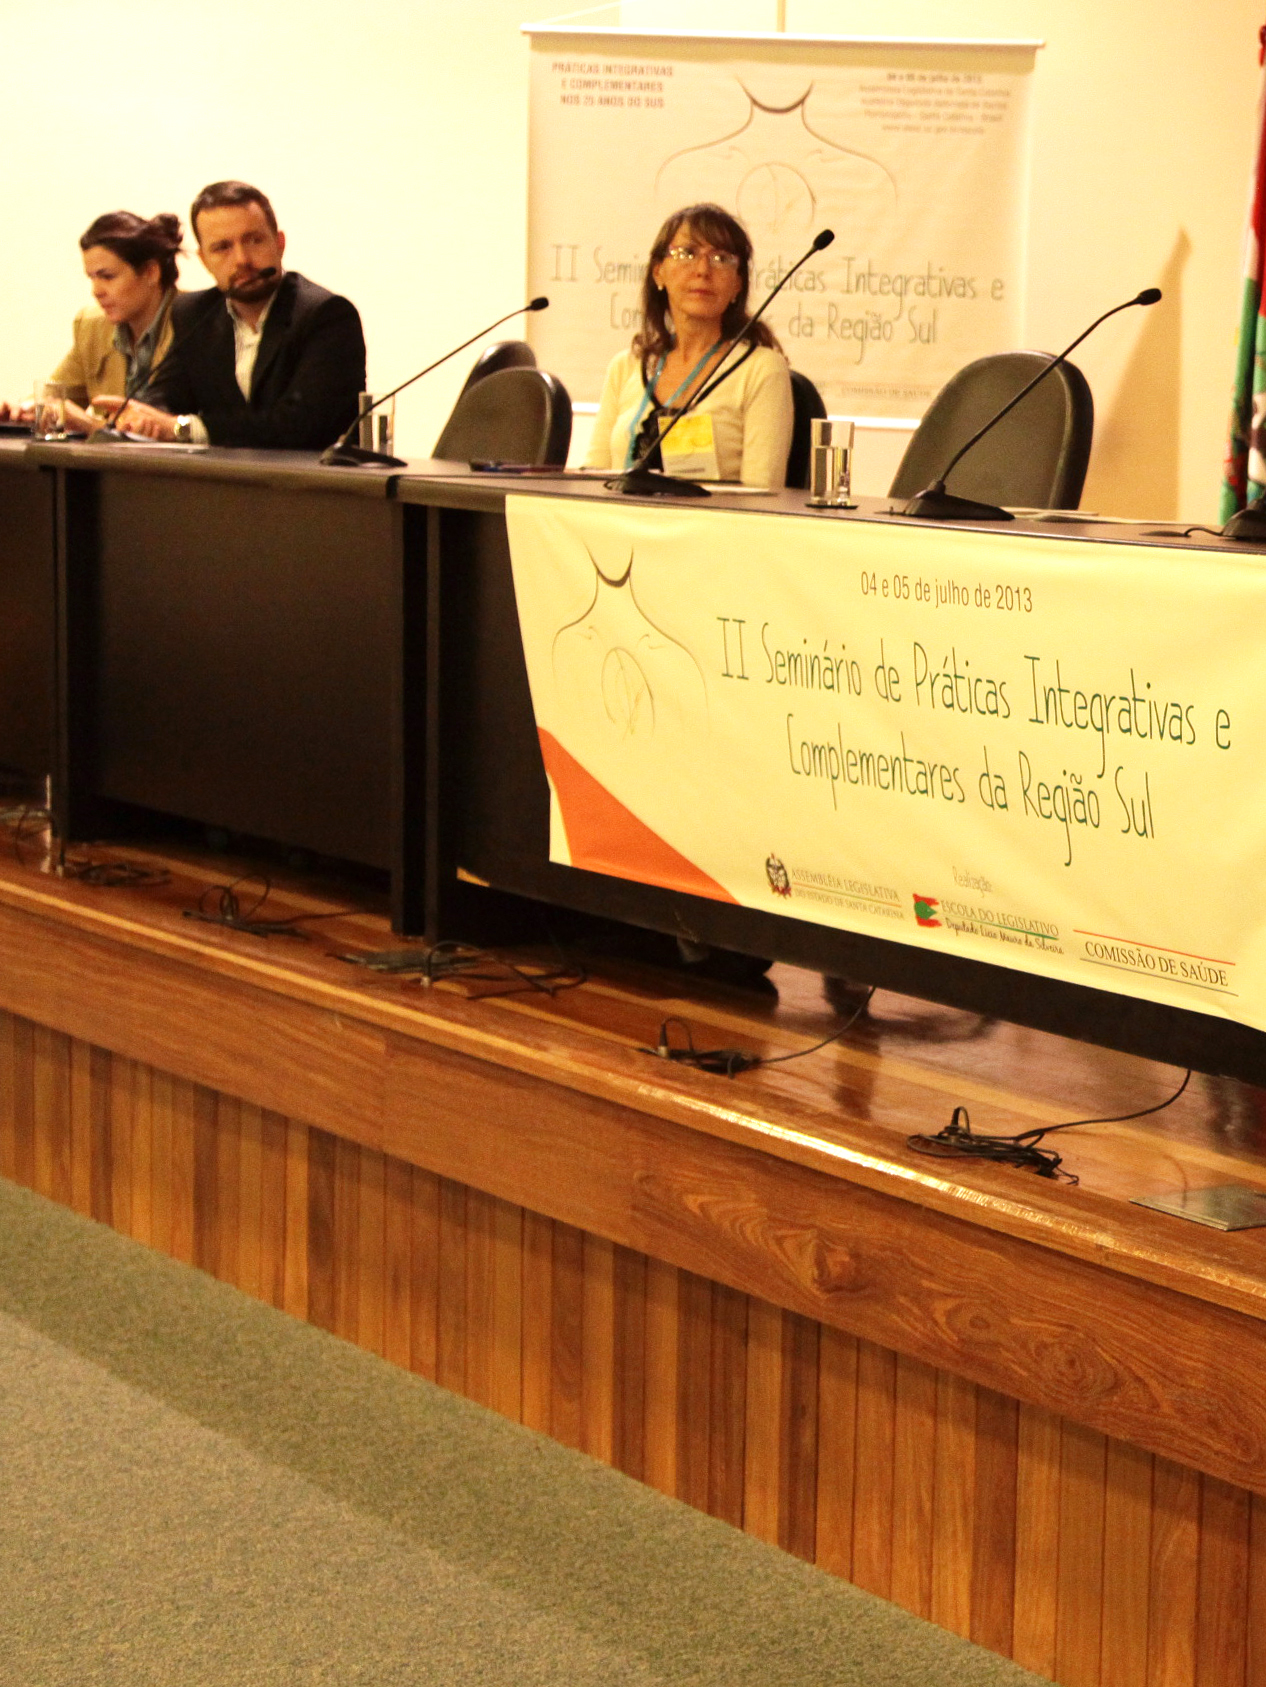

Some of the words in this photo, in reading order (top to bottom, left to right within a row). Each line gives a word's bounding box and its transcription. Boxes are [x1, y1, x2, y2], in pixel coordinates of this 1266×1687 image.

[551, 244, 580, 283] II
[843, 256, 977, 321] Integrativas
[990, 277, 1005, 301] e
[788, 301, 814, 339] da
[828, 302, 893, 365] Região
[908, 305, 939, 345] Sul
[861, 571, 878, 595] 04
[882, 578, 889, 597] e
[893, 574, 910, 600] 05
[914, 577, 931, 602] de
[935, 579, 969, 609] julho
[974, 583, 991, 609] de
[995, 584, 1033, 613] 2013
[716, 617, 749, 680] II
[761, 622, 862, 697] Seminário
[874, 637, 902, 703] de
[914, 641, 1010, 719] Práticas
[1024, 655, 1196, 779] Integrativas
[1215, 708, 1231, 749] e
[786, 713, 965, 811] Complementares
[979, 745, 1009, 811] da
[1019, 750, 1100, 867] Região
[1114, 765, 1155, 839] Sul
[843, 879, 901, 902] LEGISLATIVA
[941, 900, 976, 919] ESCOLA
[977, 908, 995, 922] DO
[996, 912, 1059, 937] LEGISLATIVO
[1084, 940, 1156, 970] COMISSÃO
[1158, 956, 1179, 976] DE
[1180, 961, 1229, 987] SAÚDE
